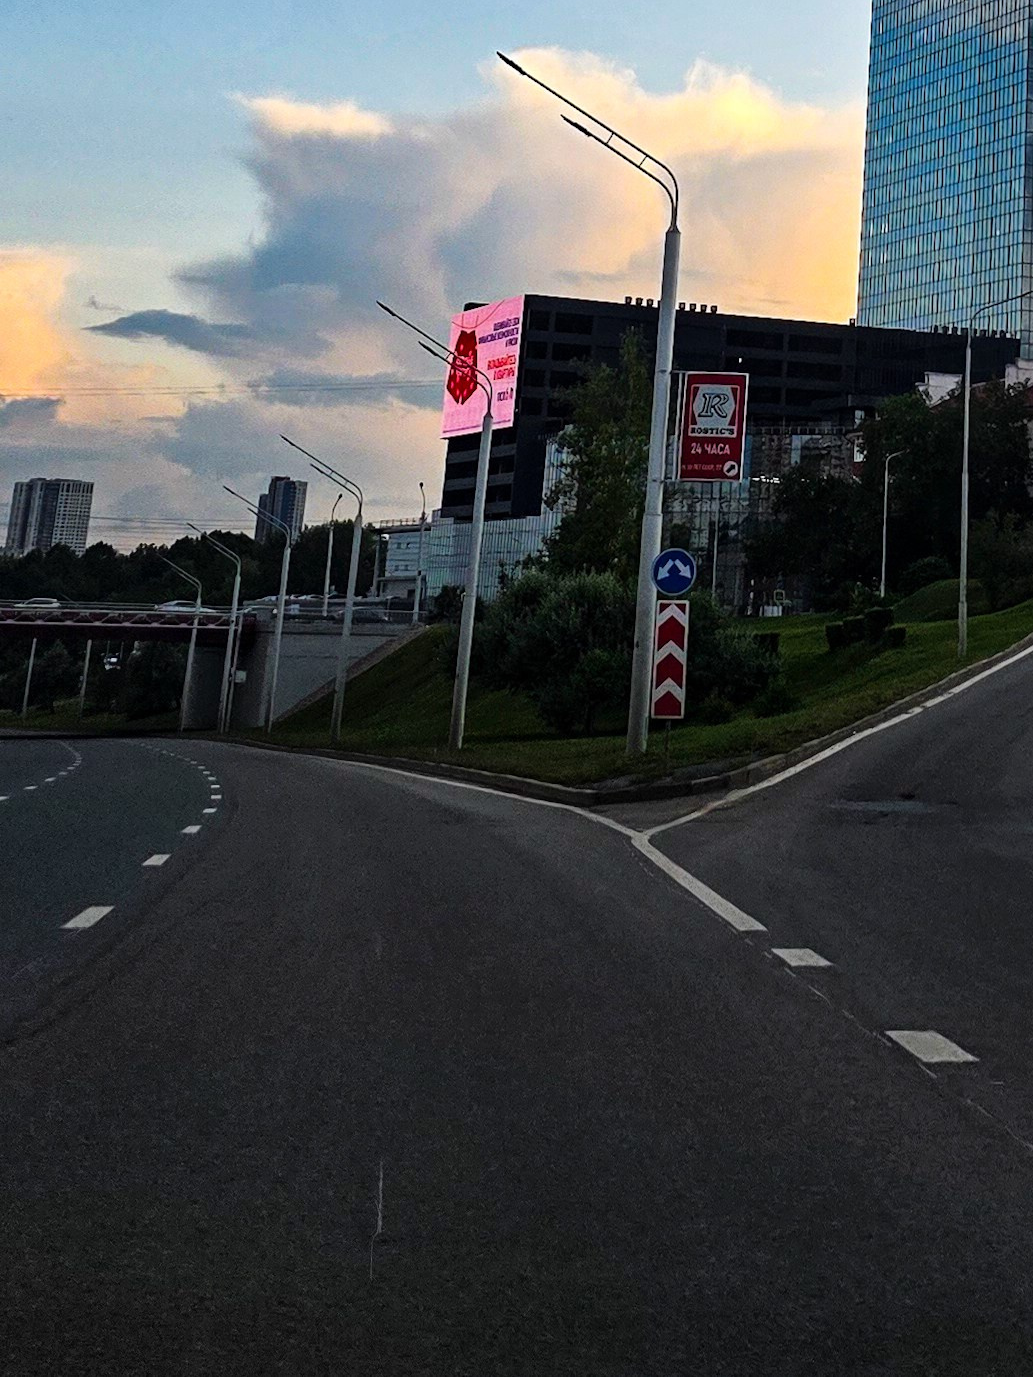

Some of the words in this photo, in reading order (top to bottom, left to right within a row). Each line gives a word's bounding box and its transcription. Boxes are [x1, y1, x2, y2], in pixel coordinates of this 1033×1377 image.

[690, 427, 735, 436] ROSTIC'S
[690, 443, 702, 455] 24
[704, 443, 730, 455] ЧАСА
